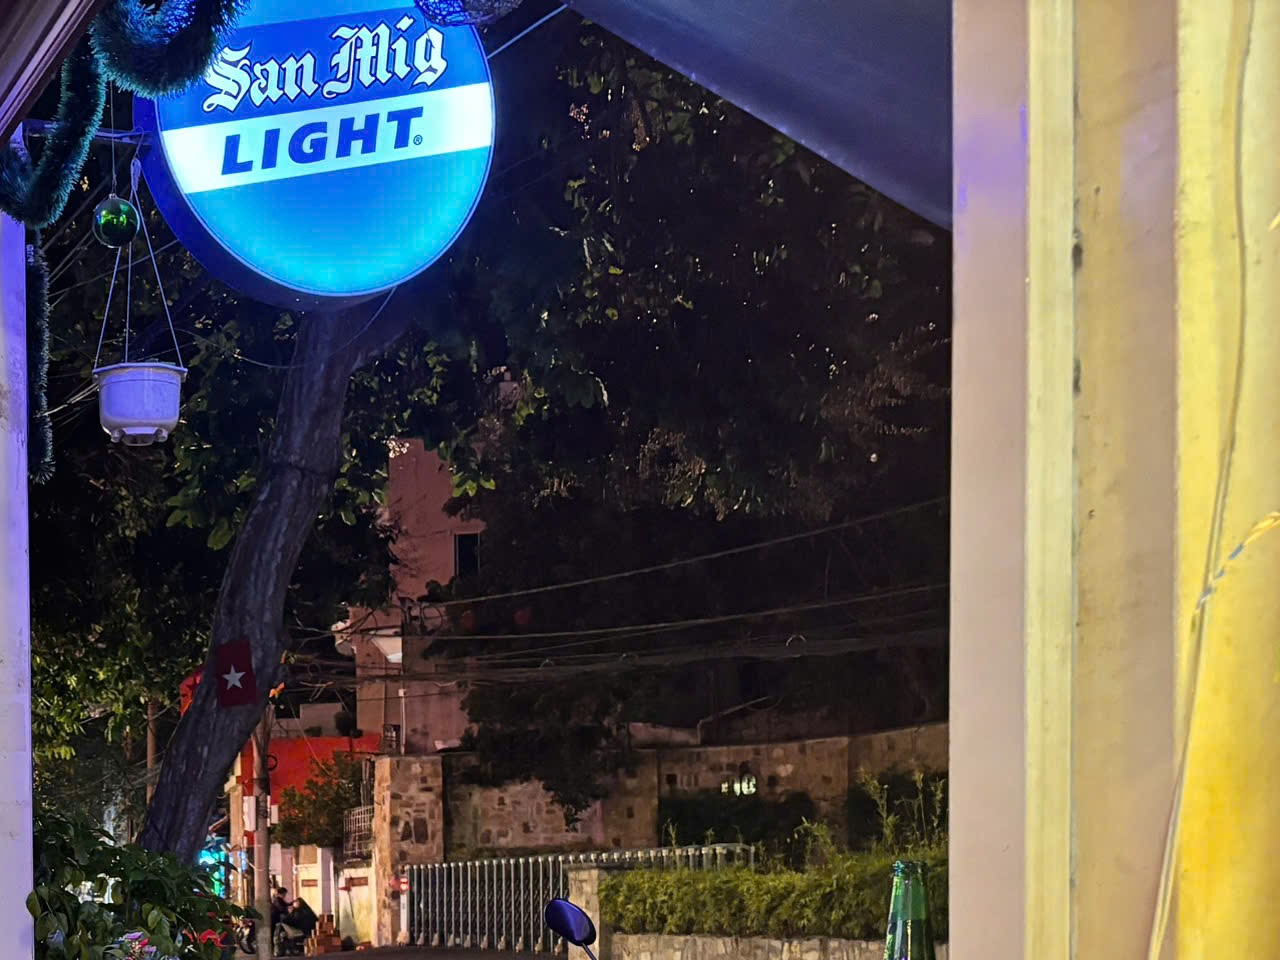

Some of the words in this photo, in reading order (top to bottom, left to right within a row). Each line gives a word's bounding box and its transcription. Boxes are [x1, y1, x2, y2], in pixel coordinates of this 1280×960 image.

[202, 40, 320, 112] San
[322, 15, 448, 99] Mig
[220, 106, 424, 176] LIGHT
